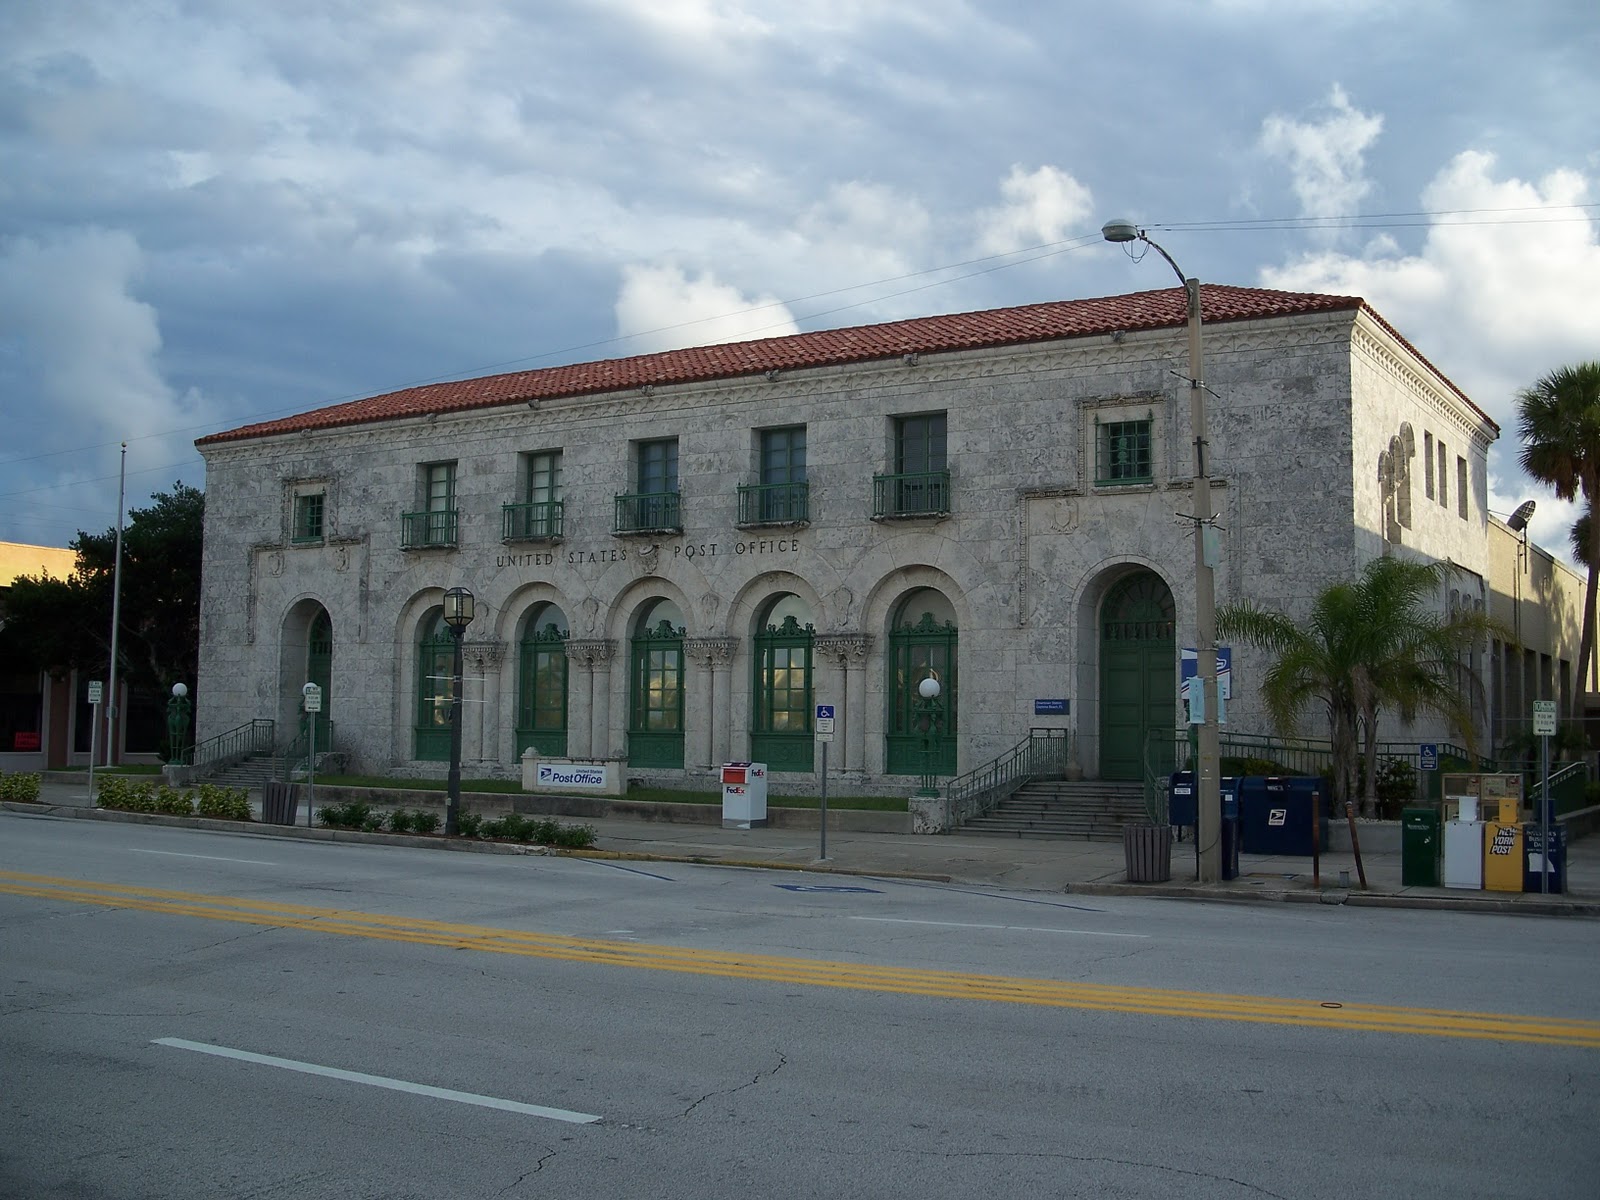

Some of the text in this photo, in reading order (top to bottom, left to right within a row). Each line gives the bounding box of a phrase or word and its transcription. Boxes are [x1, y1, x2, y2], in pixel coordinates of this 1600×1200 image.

[496, 540, 799, 567] UNITED STATES POST OFFICE
[751, 769, 764, 777] FedEx
[552, 773, 602, 784] Post Office
[726, 786, 745, 794] FedEx
[1498, 827, 1517, 836] NEW
[1494, 836, 1515, 845] YORK
[1490, 845, 1513, 854] POST
